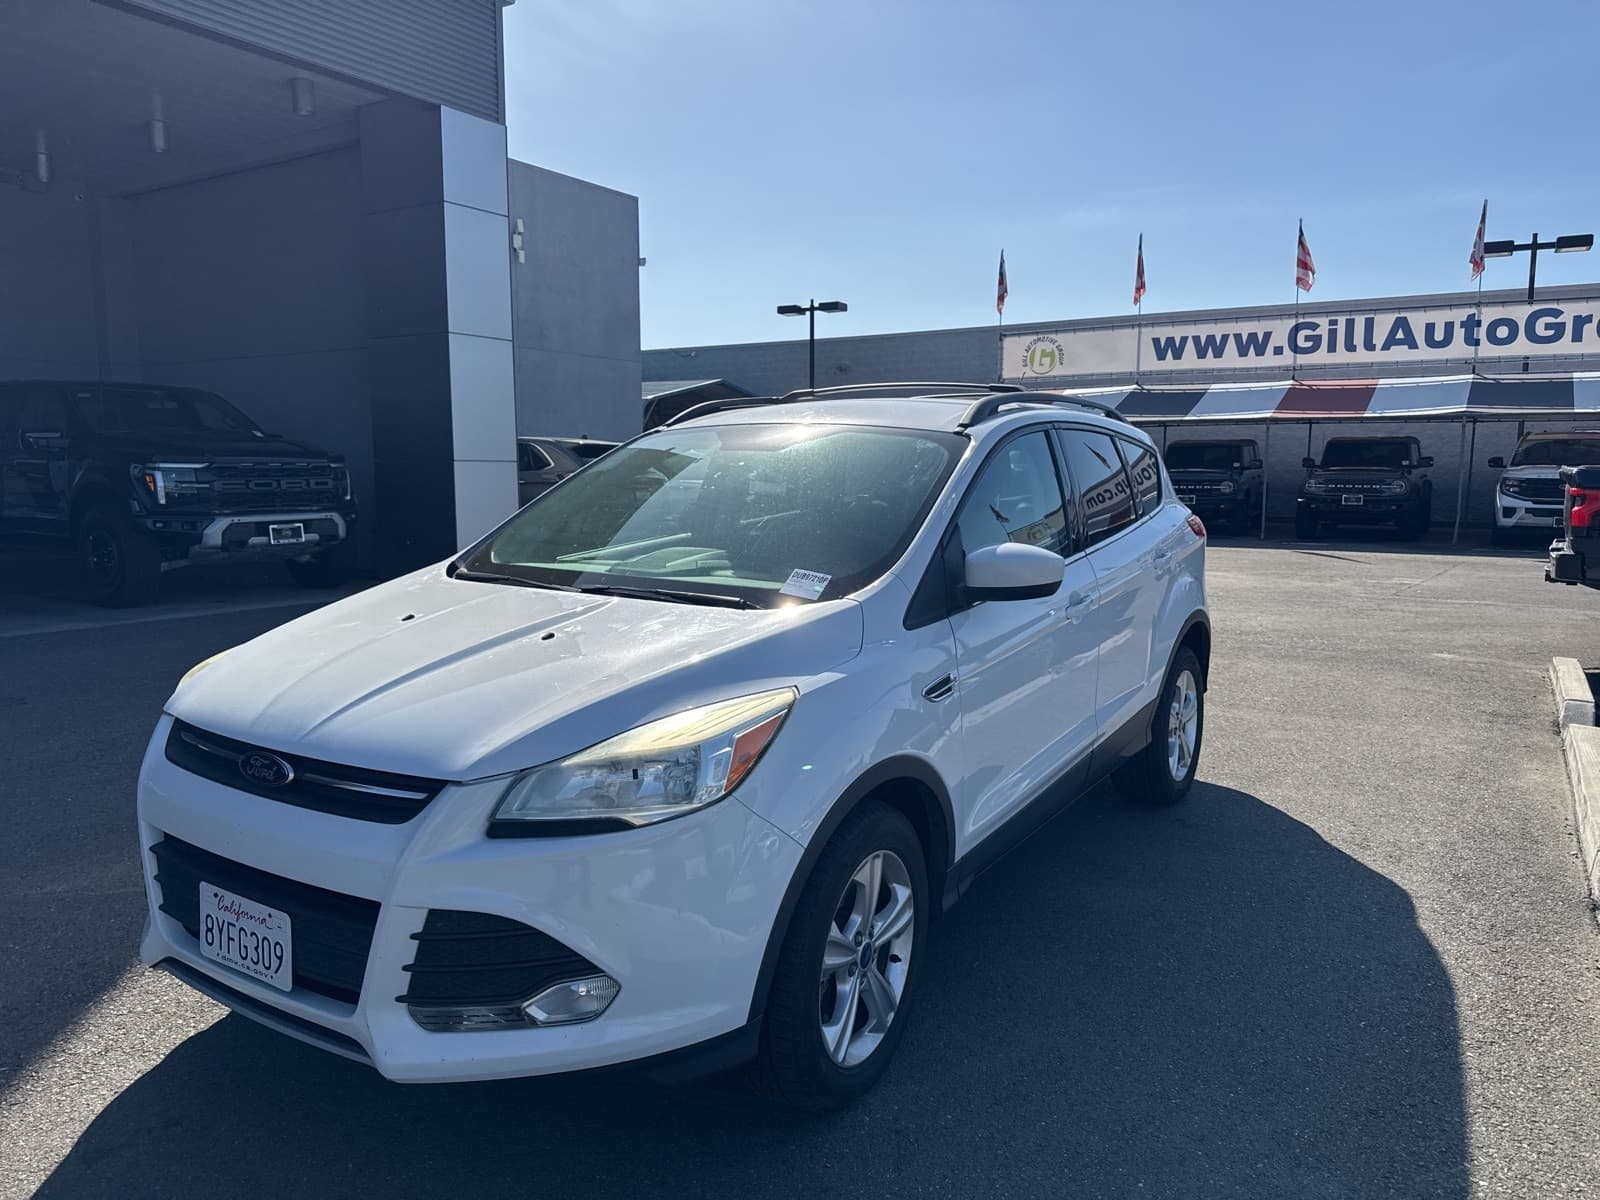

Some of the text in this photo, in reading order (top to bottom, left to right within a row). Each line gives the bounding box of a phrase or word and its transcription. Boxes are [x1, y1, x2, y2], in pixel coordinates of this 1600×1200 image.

[1151, 307, 1600, 361] www.GillAutoGr
[215, 479, 333, 491] FORD
[246, 755, 279, 780] Ford
[217, 895, 273, 930] California
[205, 913, 284, 975] 8YFG309
